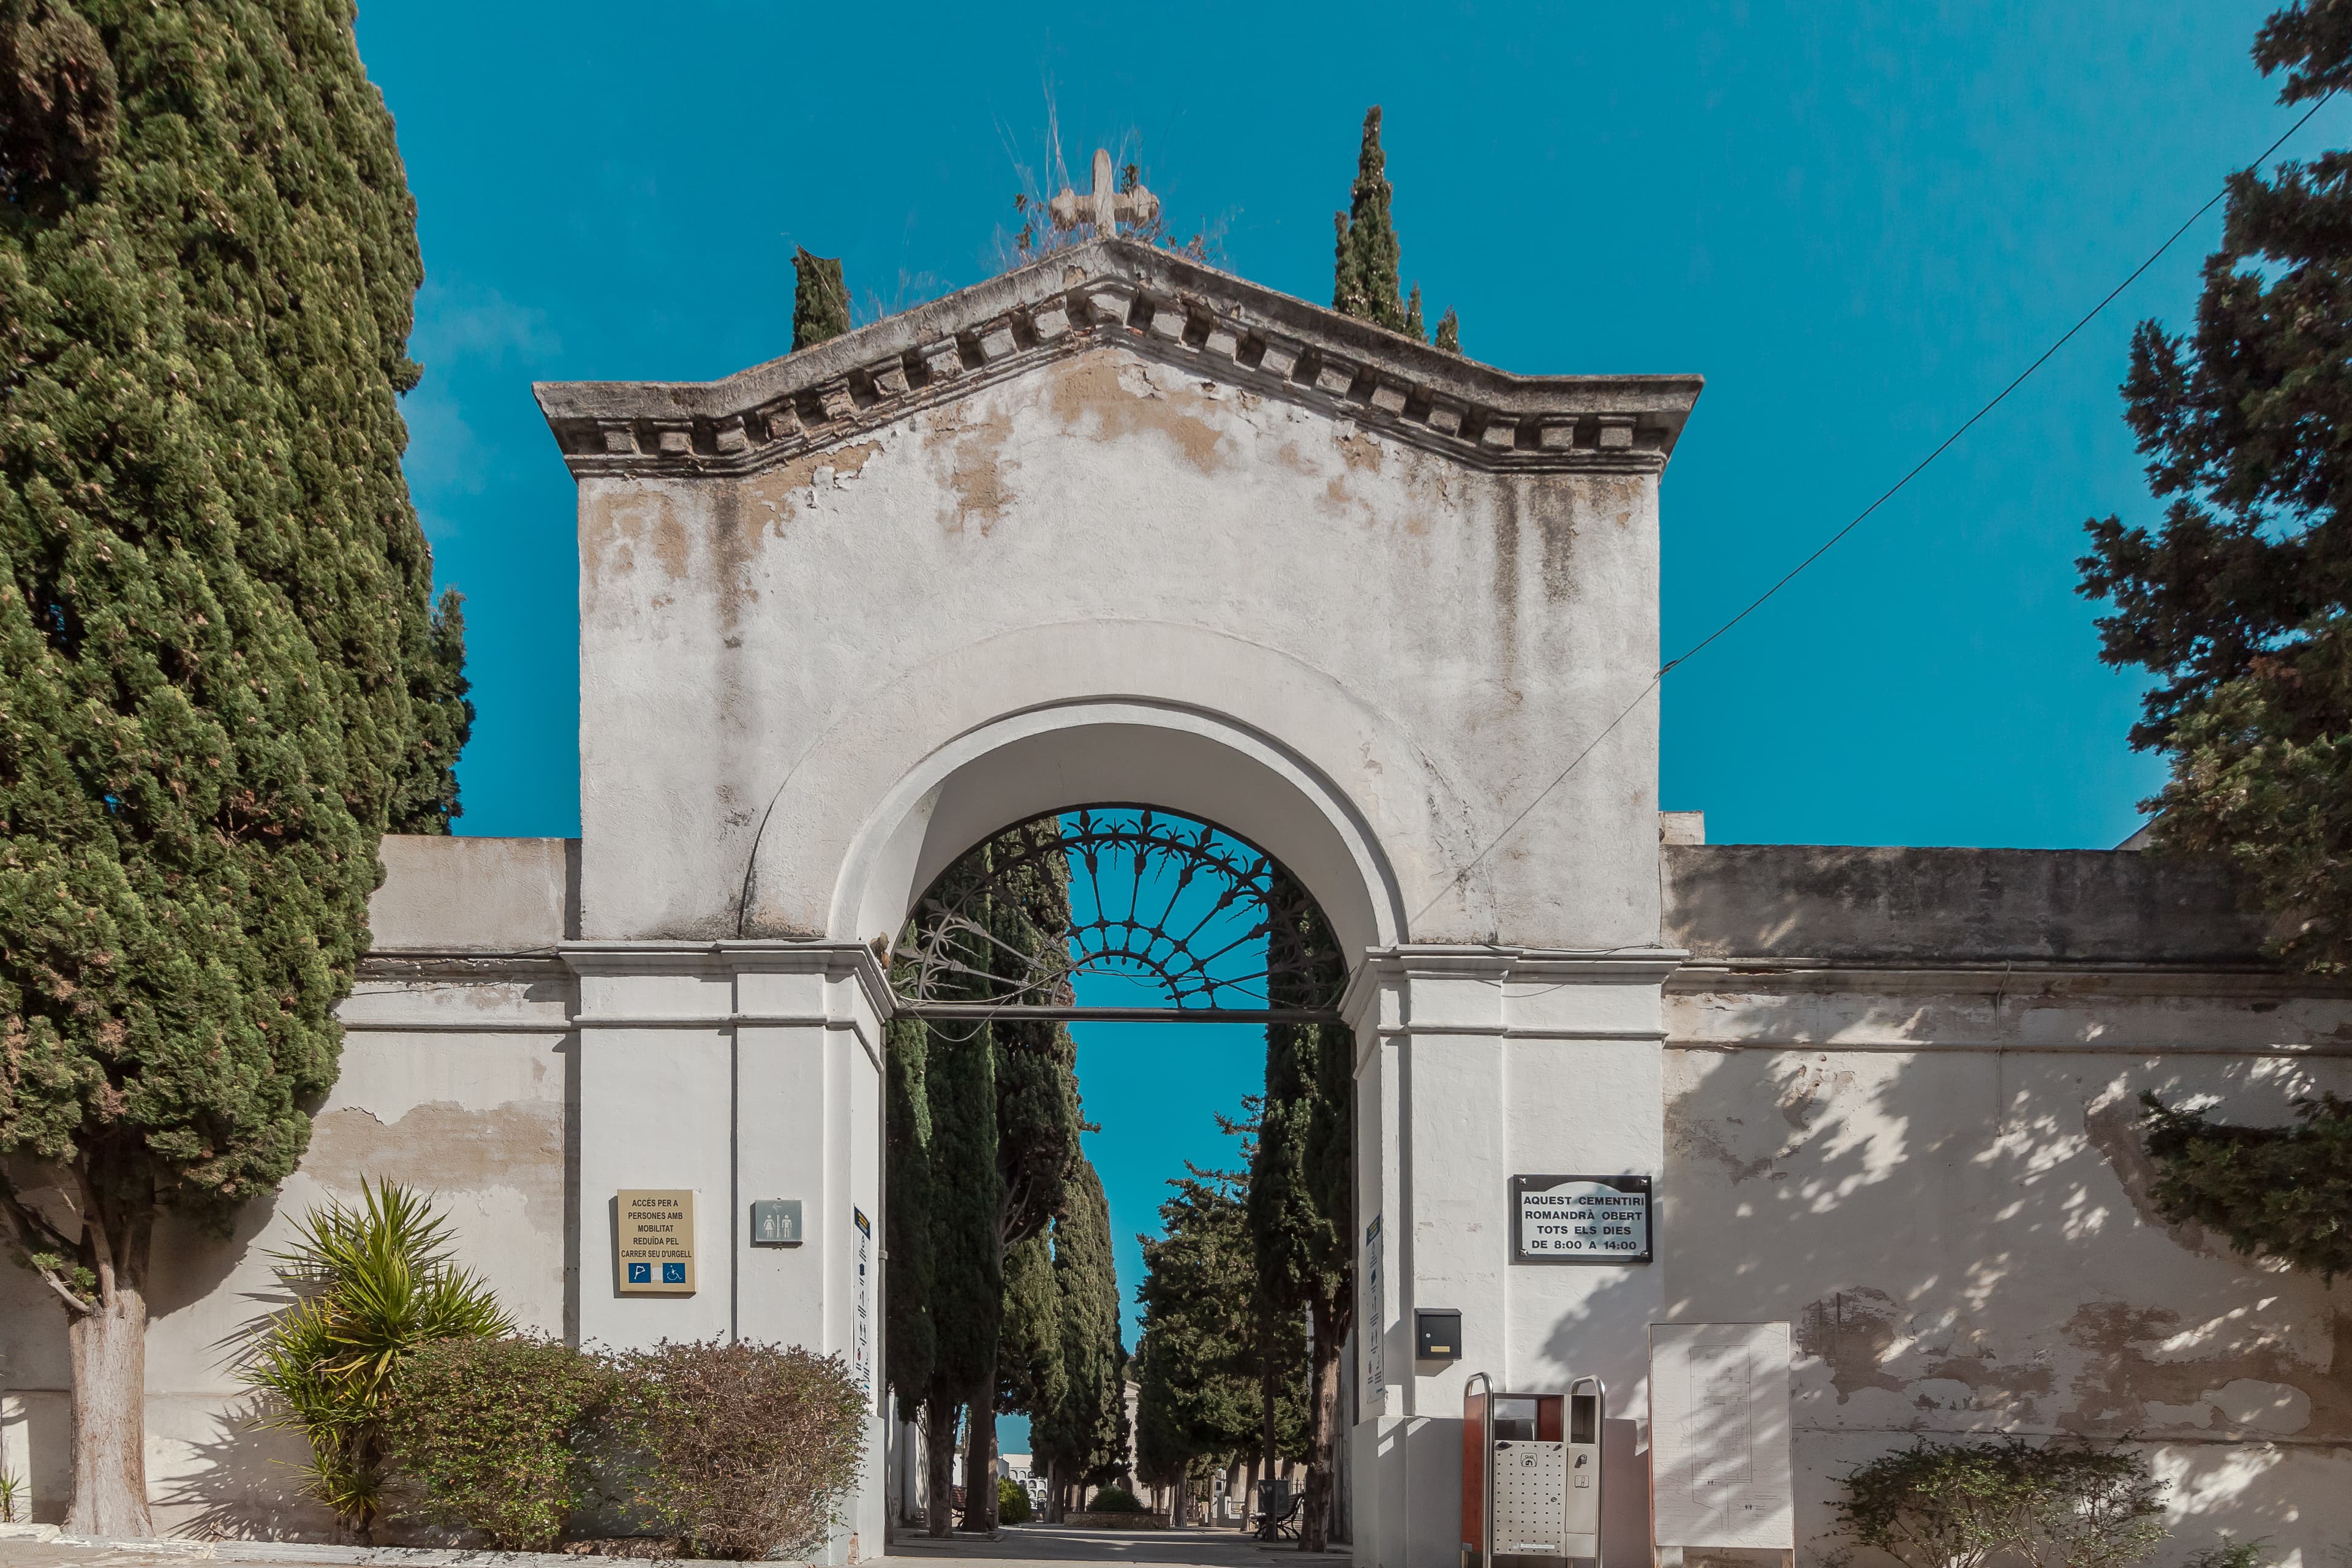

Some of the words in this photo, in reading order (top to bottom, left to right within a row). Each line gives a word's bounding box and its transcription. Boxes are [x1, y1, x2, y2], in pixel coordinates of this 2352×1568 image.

[1523, 1196, 1572, 1205] AQUEST
[1578, 1197, 1645, 1206] CEMENTIRI
[1525, 1209, 1596, 1220] ROMANDRÀ
[1537, 1226, 1569, 1234] TOTS
[1603, 1226, 1632, 1235] DIES
[633, 1236, 664, 1245] REDUÏDA
[1531, 1240, 1548, 1249] DE
[1554, 1240, 1582, 1250] 8:00
[1588, 1241, 1597, 1250] A
[1604, 1241, 1637, 1250] 14:00
